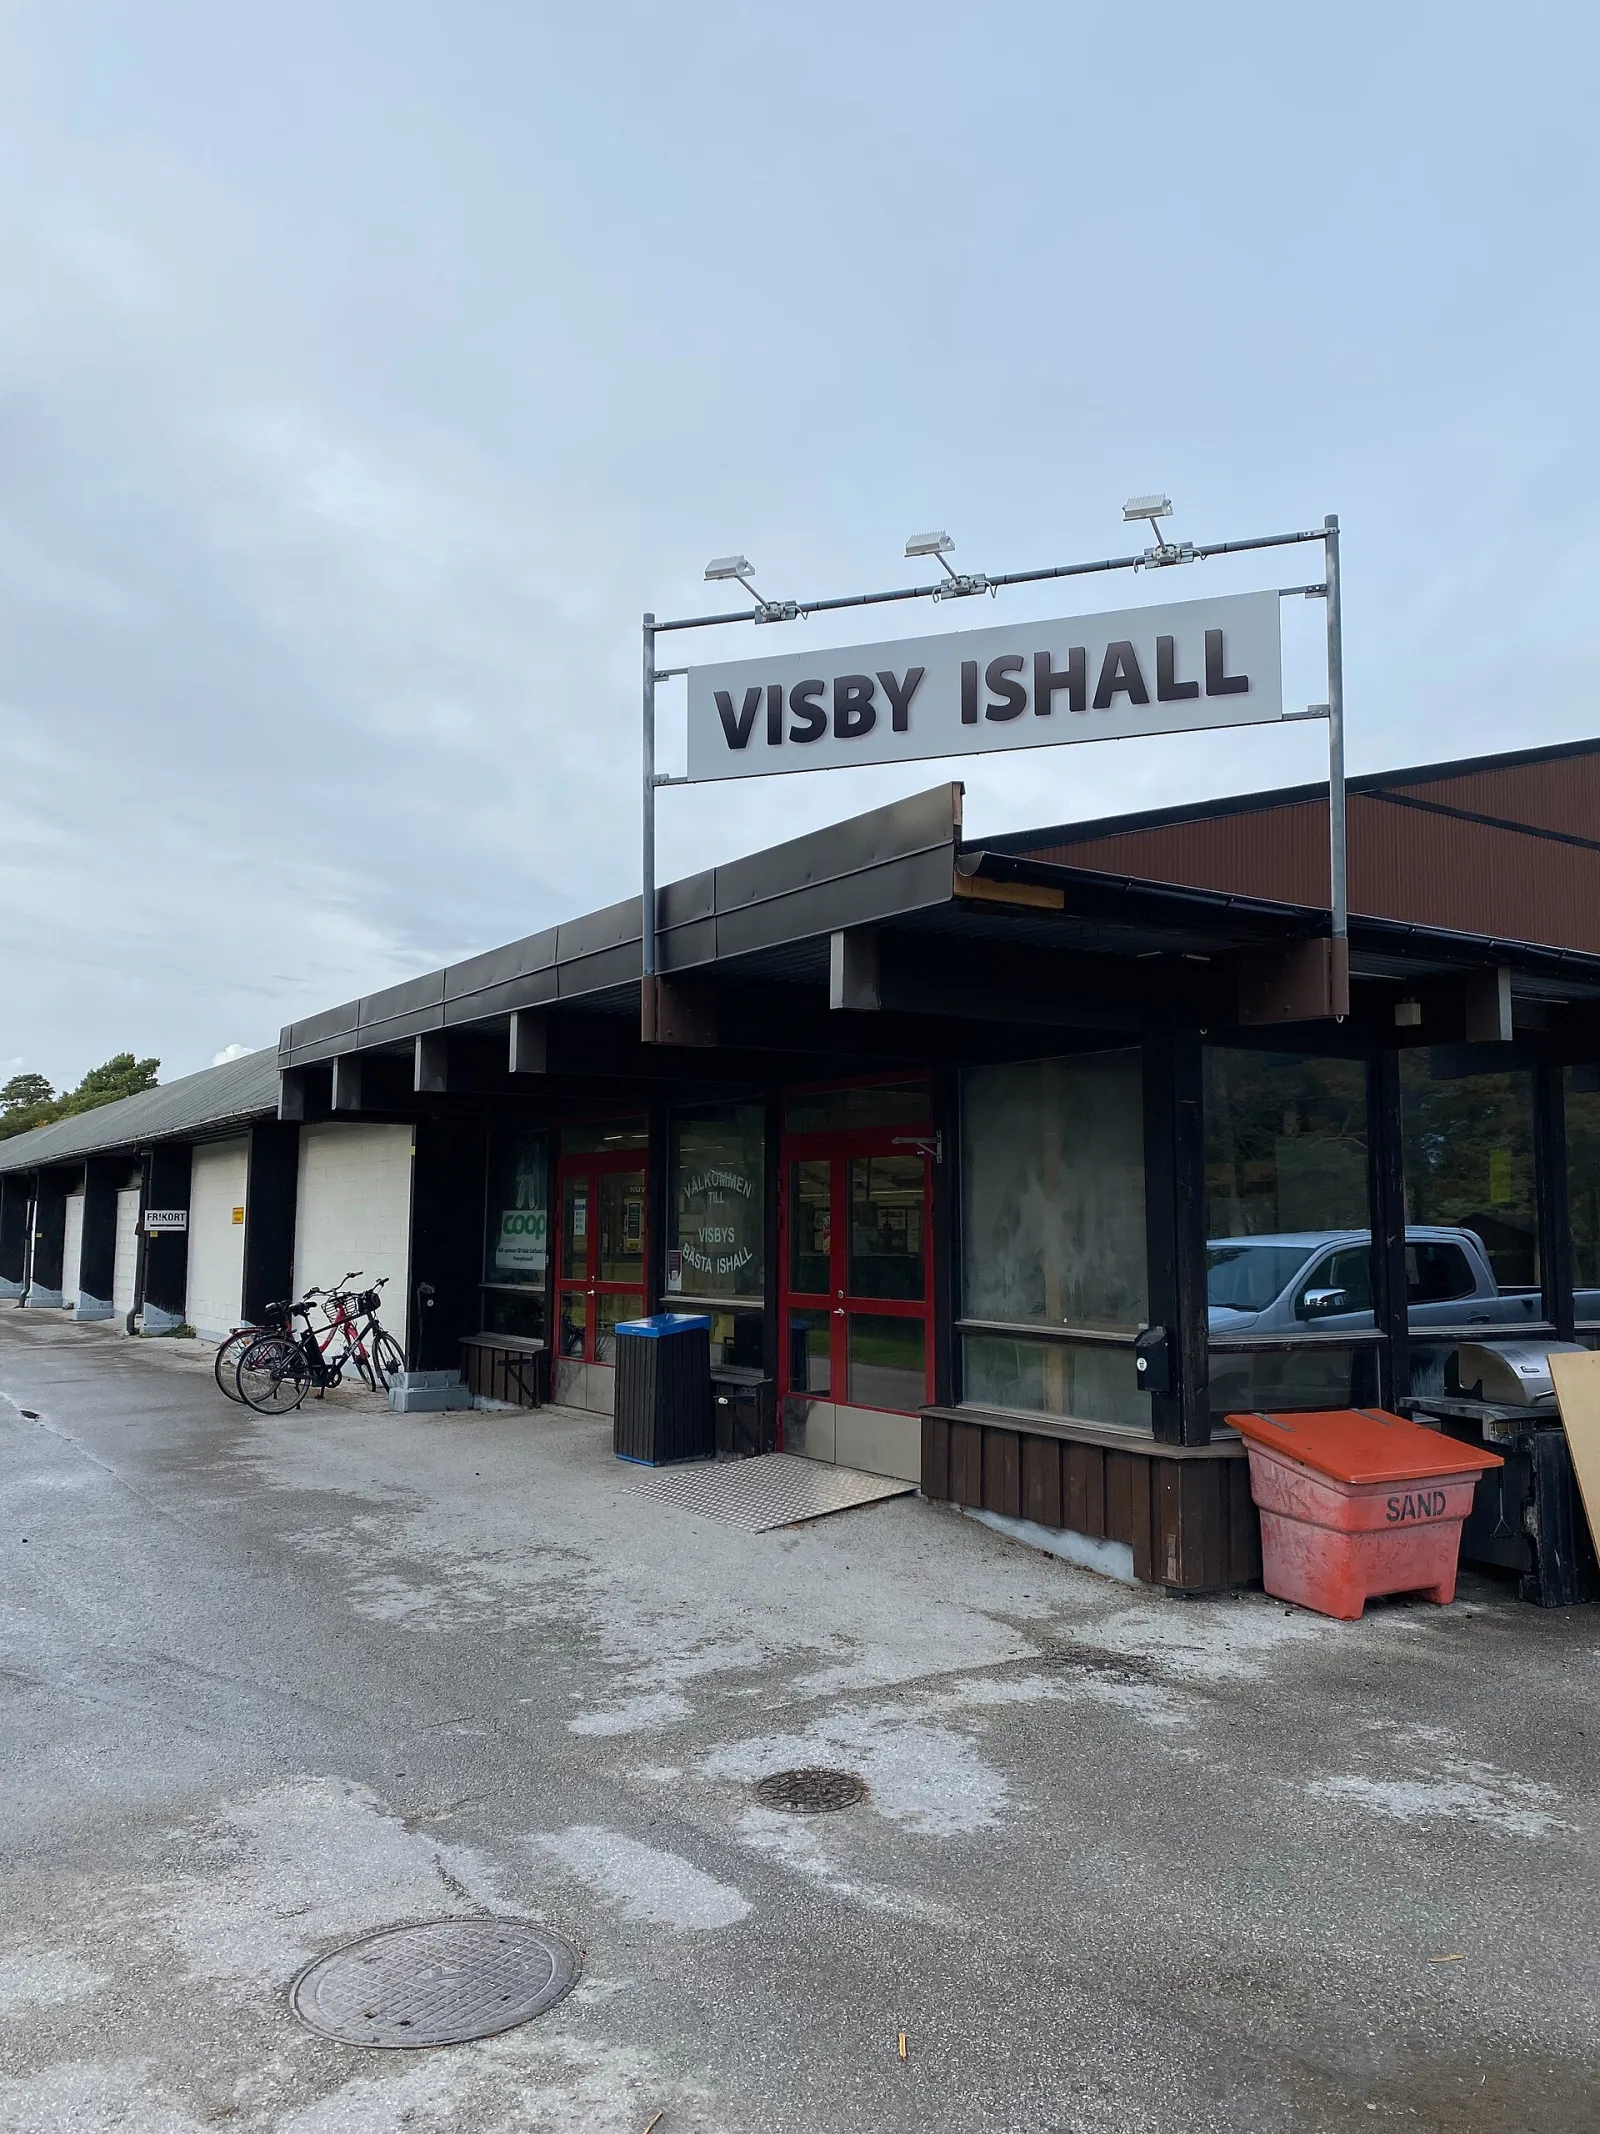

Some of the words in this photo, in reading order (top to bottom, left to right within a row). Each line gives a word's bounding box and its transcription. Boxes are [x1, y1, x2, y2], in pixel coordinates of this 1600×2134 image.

[713, 666, 926, 750] VISBY
[961, 628, 1249, 724] ISHALL
[684, 1171, 752, 1199] VÄLKOMMEN
[708, 1191, 725, 1204] TILL
[503, 1214, 546, 1240] coop
[699, 1226, 735, 1243] VISBYS
[682, 1243, 712, 1274] BÄSTA
[717, 1246, 753, 1274] ISHALL
[1386, 1491, 1446, 1522] SAND
